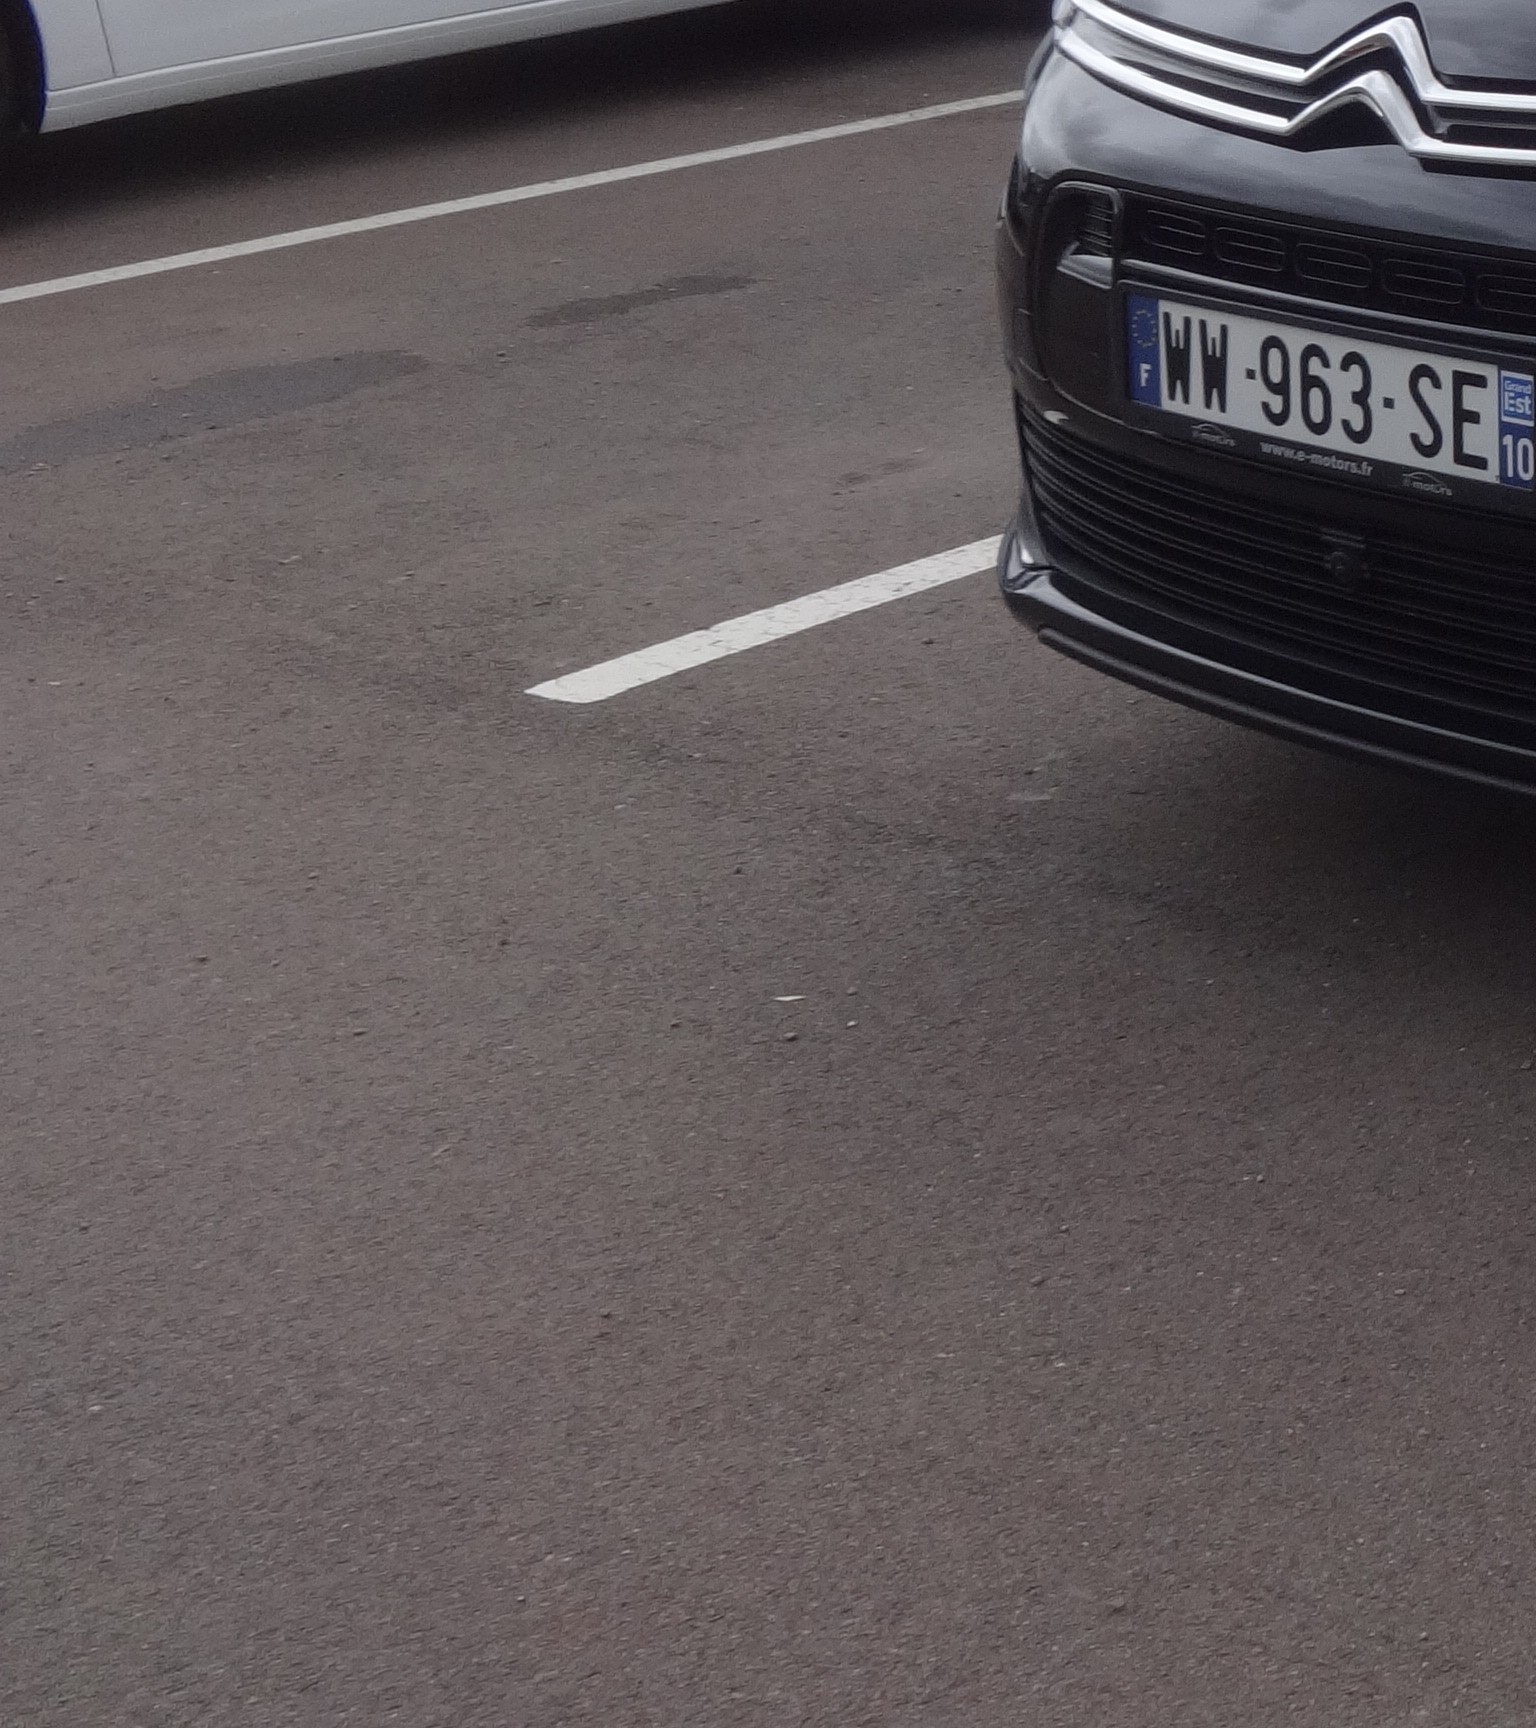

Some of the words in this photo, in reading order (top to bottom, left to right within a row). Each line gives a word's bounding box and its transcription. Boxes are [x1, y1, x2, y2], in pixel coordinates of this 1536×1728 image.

[1140, 363, 1153, 387] F
[1504, 380, 1532, 394] Grand
[1162, 311, 1489, 471] WW-963-SE
[1504, 391, 1532, 415] Est
[1259, 441, 1374, 477] www.e-motors.fr
[1502, 434, 1535, 481] 10
